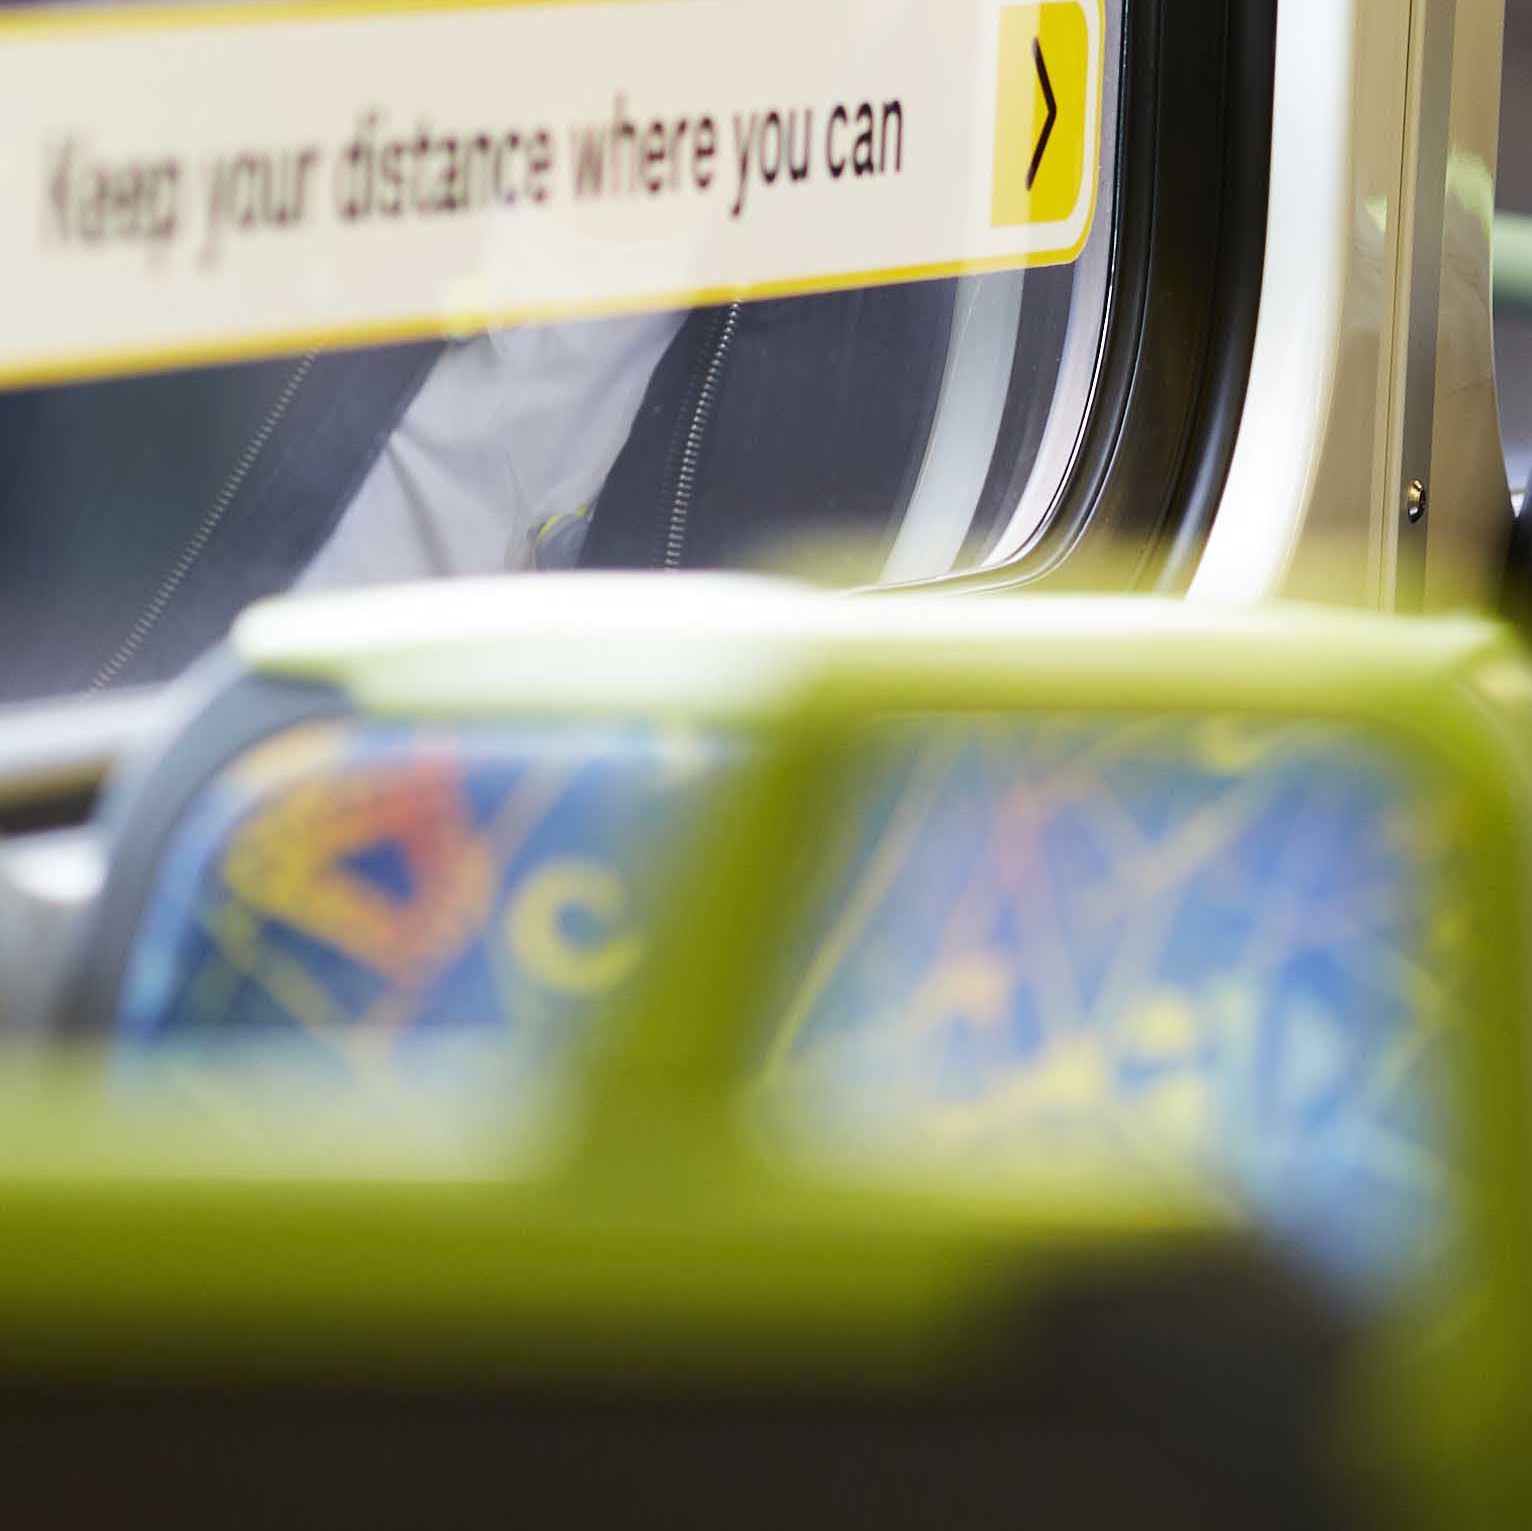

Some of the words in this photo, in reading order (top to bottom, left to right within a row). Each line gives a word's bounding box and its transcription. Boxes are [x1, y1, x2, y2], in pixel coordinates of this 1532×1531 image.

[48, 132, 181, 262] Keep
[198, 148, 318, 268] your
[336, 107, 551, 220] distance
[572, 90, 716, 201] where
[731, 108, 812, 218] you
[826, 100, 902, 178] can
